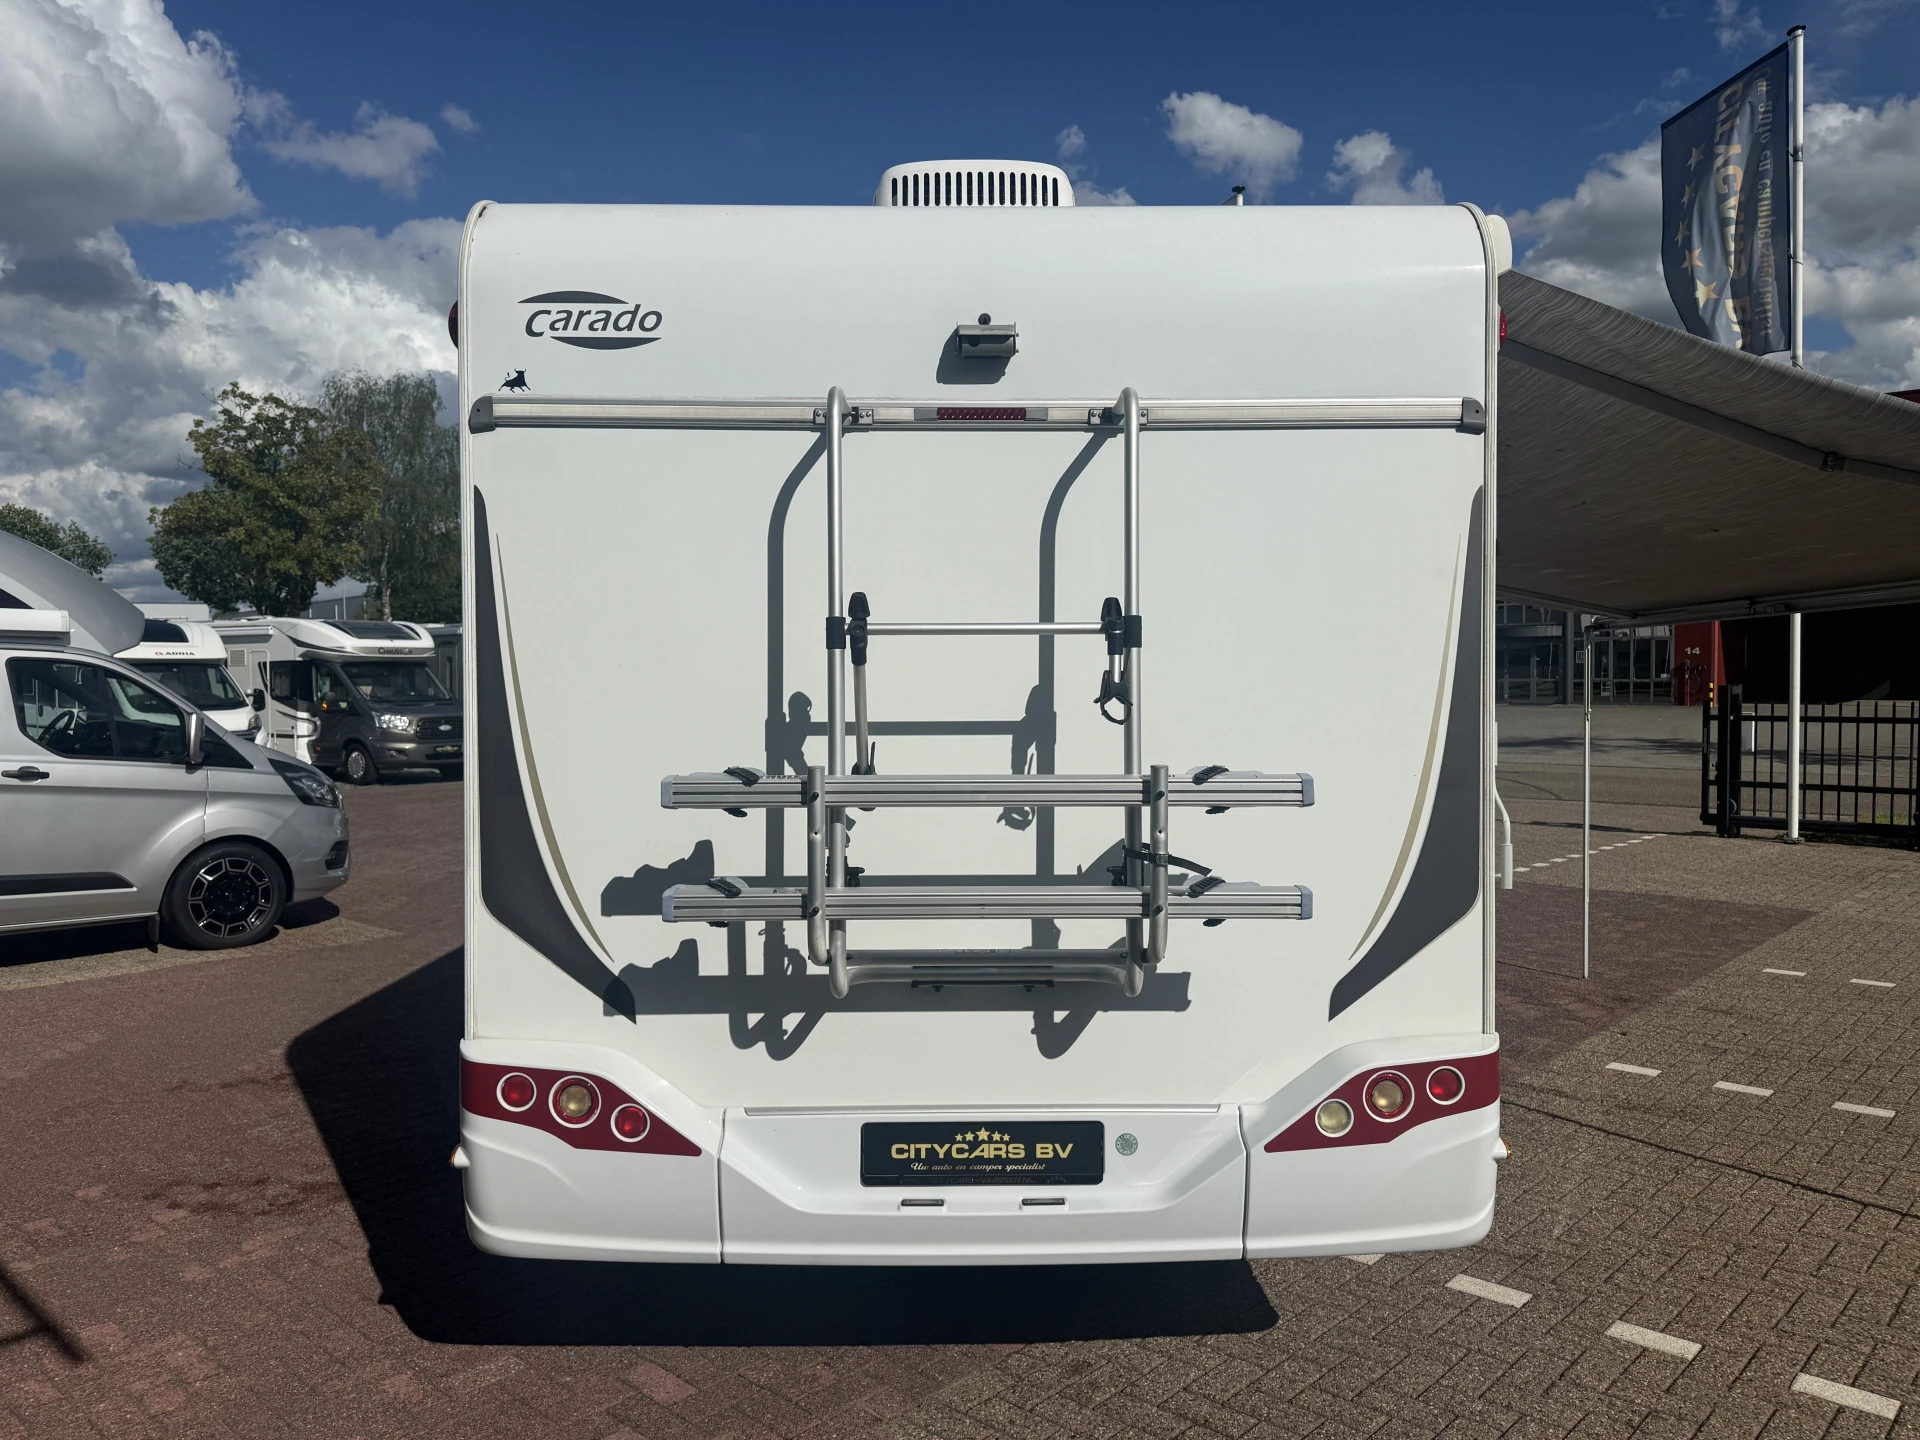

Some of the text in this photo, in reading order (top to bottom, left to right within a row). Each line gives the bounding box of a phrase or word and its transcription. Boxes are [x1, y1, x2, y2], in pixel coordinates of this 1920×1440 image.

[525, 304, 662, 337] carado
[891, 1143, 1074, 1159] CITYCARS BV
[911, 1162, 929, 1171] Uw
[970, 1164, 1002, 1172] camper
[1005, 1162, 1046, 1172] specialist
